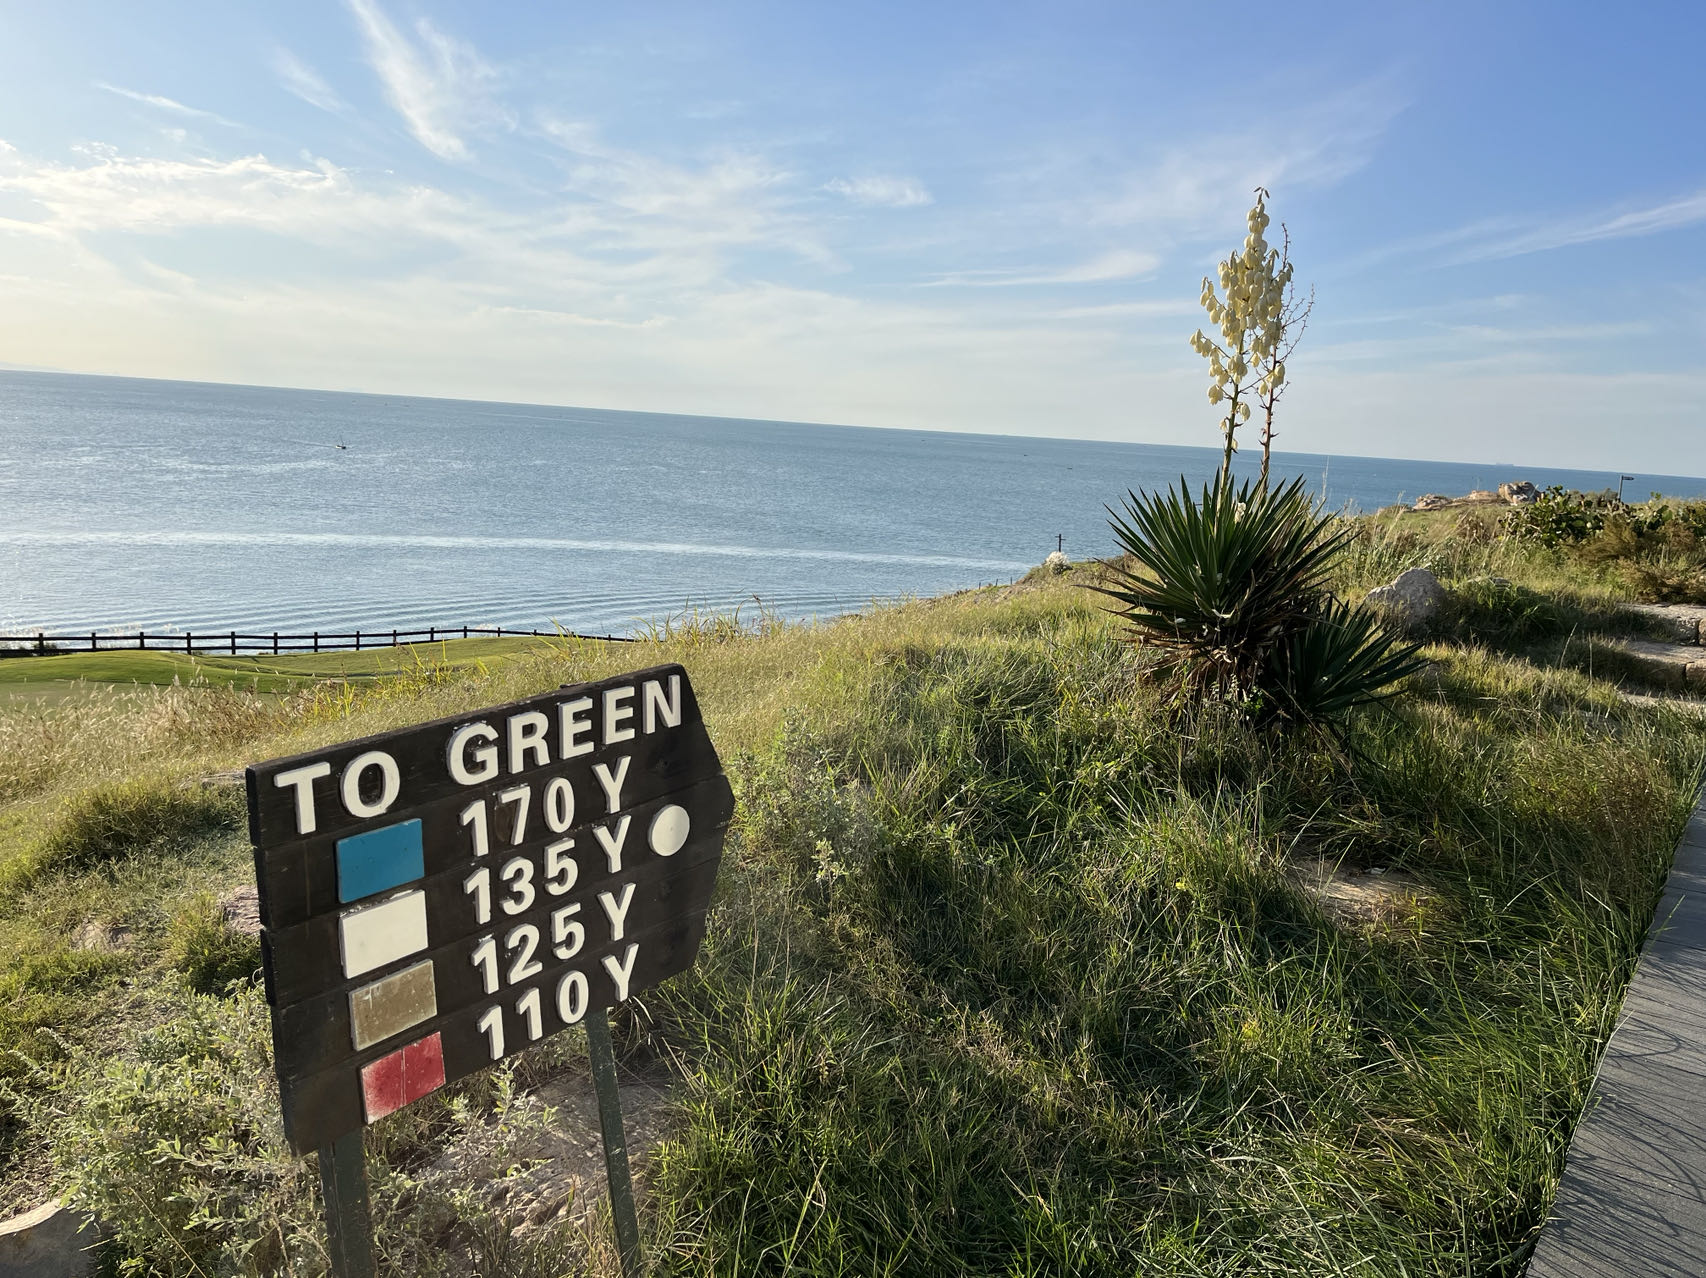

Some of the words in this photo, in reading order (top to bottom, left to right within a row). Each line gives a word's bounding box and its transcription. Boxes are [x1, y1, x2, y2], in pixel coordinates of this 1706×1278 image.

[274, 750, 401, 835] TO
[446, 674, 683, 786] GREEN
[460, 776, 575, 857] 170
[592, 755, 632, 814] Y
[463, 838, 580, 925] 135
[593, 814, 632, 873] Y
[471, 902, 586, 994] 125
[597, 882, 637, 942] Y
[477, 970, 590, 1060] 110
[601, 942, 640, 1002] Y
